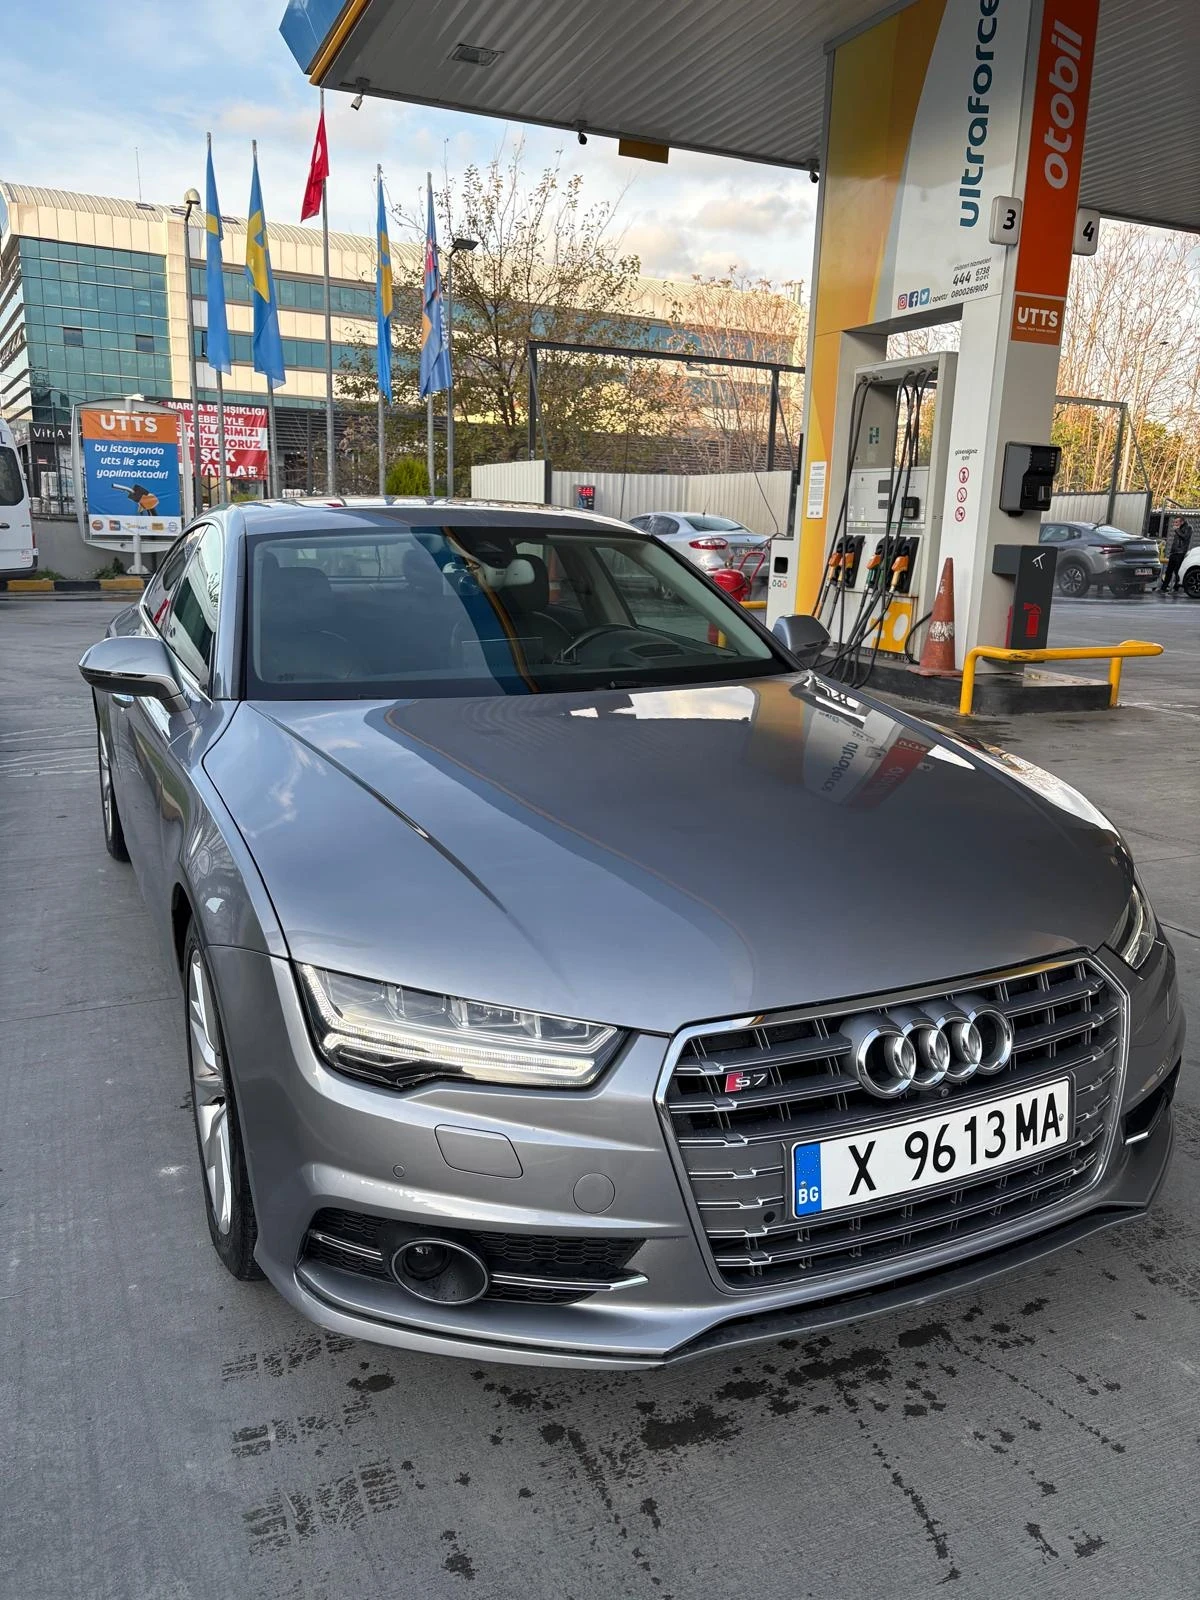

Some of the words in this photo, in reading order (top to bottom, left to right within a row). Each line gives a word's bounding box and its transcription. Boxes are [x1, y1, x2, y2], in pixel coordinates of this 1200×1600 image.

[1044, 19, 1083, 190] otobil
[1002, 209, 1017, 230] 3
[1082, 221, 1095, 242] 4
[952, 271, 972, 286] 444
[1017, 306, 1059, 328] UTTS
[100, 414, 158, 433] UTTS
[94, 444, 107, 452] bu
[110, 444, 164, 455] istasyonda
[101, 457, 121, 465] utts
[123, 456, 135, 466] ile
[137, 459, 160, 468] satış
[96, 469, 169, 480] yapılmaktadır!
[735, 1073, 768, 1087] S7
[848, 1140, 877, 1197] X
[799, 1186, 819, 1205] BG
